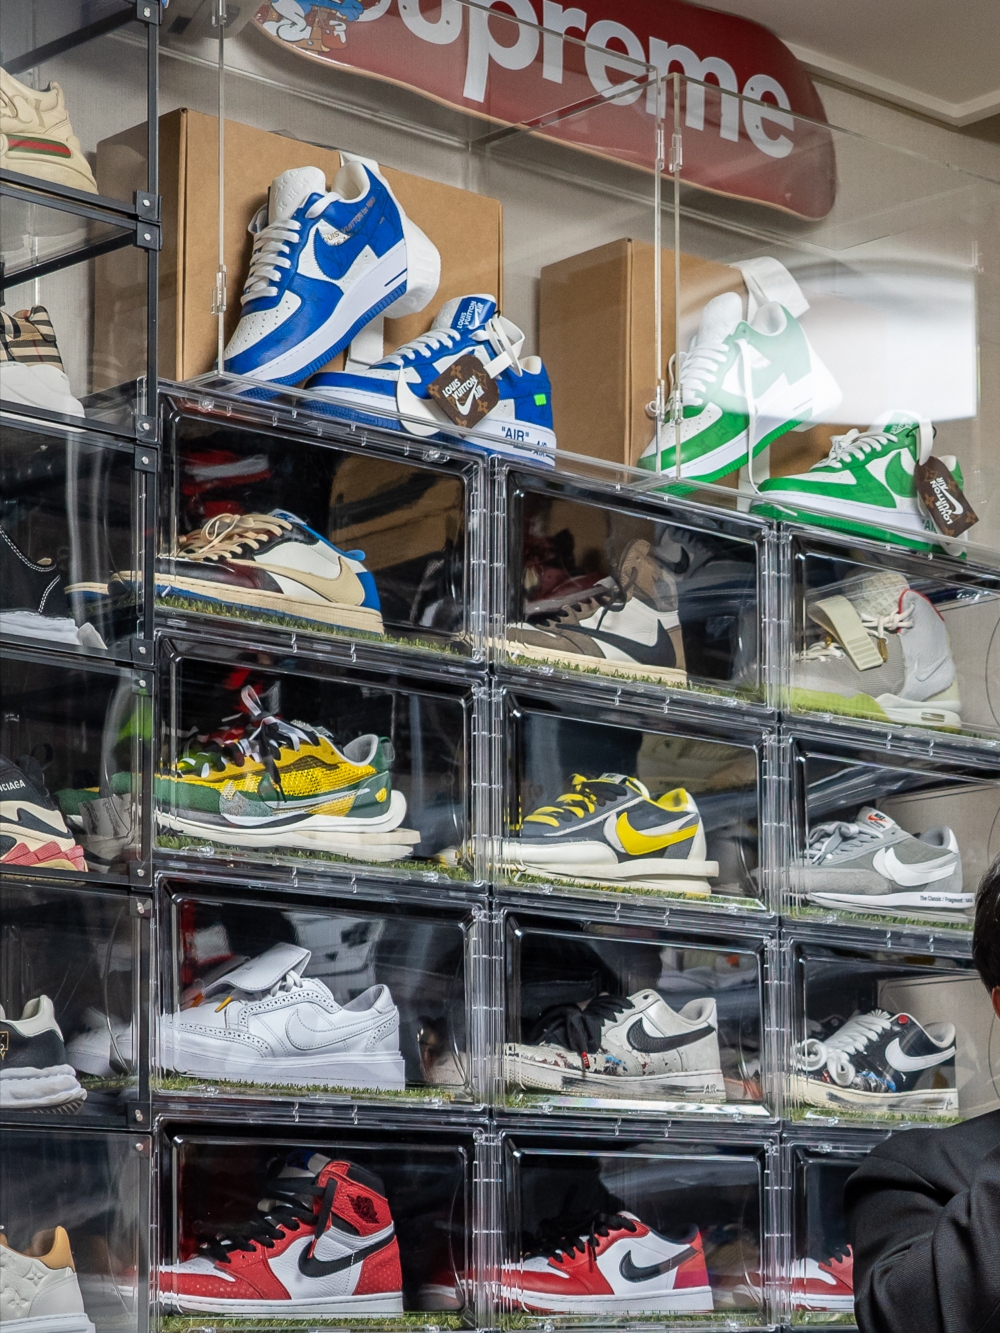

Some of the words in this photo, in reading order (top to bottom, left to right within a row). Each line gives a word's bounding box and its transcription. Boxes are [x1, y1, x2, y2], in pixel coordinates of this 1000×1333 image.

[352, 0, 795, 159] upreme
[464, 301, 477, 326] VUITTON
[477, 302, 485, 314] AIR
[457, 312, 467, 329] LOUIS
[442, 378, 462, 398] LOUIS
[452, 375, 478, 400] VUITTON
[474, 385, 485, 400] AIR
[501, 426, 529, 443] "AIR"
[935, 477, 949, 490] AIR
[929, 480, 955, 516] VUITTON
[935, 501, 954, 525] LOUIS
